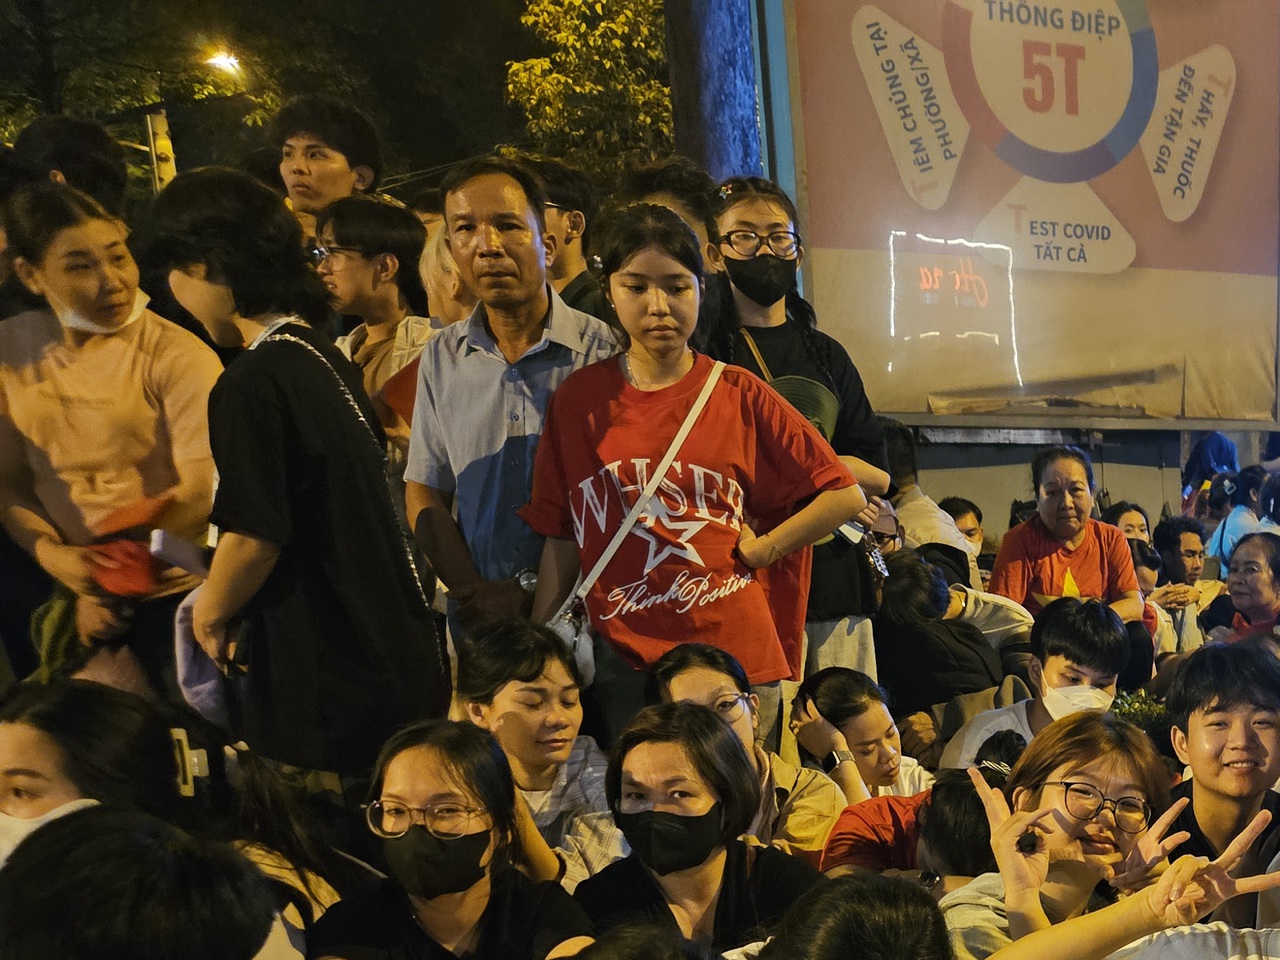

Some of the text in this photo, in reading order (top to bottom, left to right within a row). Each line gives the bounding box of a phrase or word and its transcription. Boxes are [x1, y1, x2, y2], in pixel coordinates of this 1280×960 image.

[866, 21, 889, 56] TẠI
[1070, 8, 1121, 41] ĐIỆP
[1022, 39, 1086, 117] 5T
[1153, 64, 1196, 175] ĐẾN TẬN GIA
[1173, 137, 1202, 200] THUỐC
[1033, 240, 1062, 261] TẤT
[1063, 222, 1111, 241] COVID
[599, 569, 690, 621] Think
